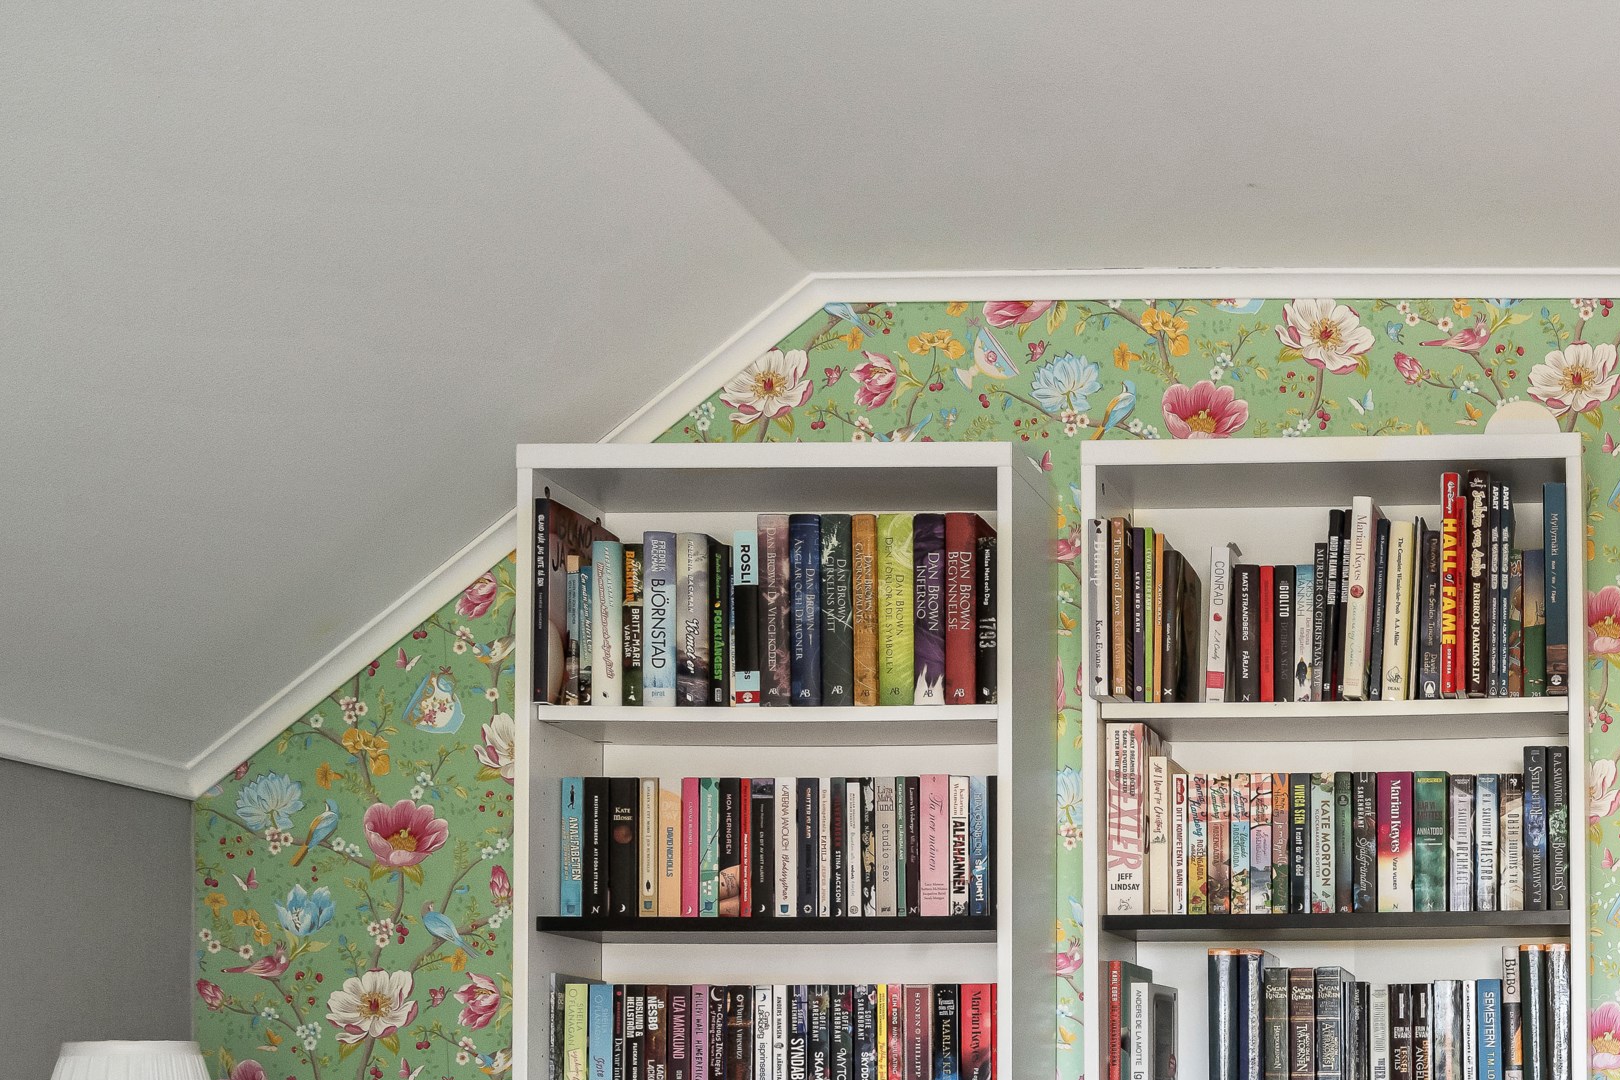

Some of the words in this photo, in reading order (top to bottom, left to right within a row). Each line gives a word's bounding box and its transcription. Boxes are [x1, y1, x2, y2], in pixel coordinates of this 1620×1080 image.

[1355, 514, 1367, 550] Marian
[1443, 518, 1457, 572] HALL
[658, 540, 666, 572] FREDRIK
[794, 538, 803, 579] ÄNGLAR
[836, 559, 846, 582] DAN
[864, 555, 872, 577] DAN
[928, 552, 939, 579] DAN
[960, 551, 971, 579] DAN
[1114, 558, 1122, 580] Food
[1316, 549, 1324, 592] MURDER
[1352, 552, 1365, 581] Keyes
[794, 582, 803, 604] OCH
[806, 568, 815, 590] DAN
[864, 580, 873, 611] BROWN
[895, 574, 904, 596] DAN
[916, 565, 926, 619] INFERNO
[948, 551, 958, 631] BEGYNNELSE
[1114, 582, 1122, 591] of
[1214, 561, 1224, 606] CONRAD
[1445, 574, 1454, 583] of
[806, 594, 815, 631] BROWN
[836, 585, 846, 623] BROWN
[896, 600, 904, 636] BROWN
[928, 585, 939, 631] BROWN
[960, 584, 971, 630] BROWN
[1114, 594, 1122, 615] Love
[1280, 585, 1289, 617] GIOLITO
[1315, 594, 1323, 609] ON
[1442, 586, 1456, 645] FAME
[1473, 582, 1481, 624] FARBROR
[632, 608, 640, 667] BRITT-MARIE
[651, 578, 669, 669] BJÖRNSTAD
[794, 609, 803, 660] DEMONER
[979, 617, 996, 648] 1793
[1314, 611, 1323, 666] CHRISTMAS
[1472, 625, 1480, 666] JOAKIMS
[1313, 669, 1321, 687] EVE
[1472, 668, 1480, 684] LIV
[1321, 800, 1330, 829] KATE
[1391, 780, 1401, 819] Marian
[1107, 770, 1143, 870] DEXTER
[1389, 820, 1401, 853] Keyes
[569, 817, 582, 881] ANALFABETEN
[882, 823, 891, 859] studio
[952, 820, 965, 894] ALFAHANNEN
[1322, 832, 1331, 886] MORTON
[1481, 841, 1493, 880] MAESTRO
[1504, 958, 1517, 995] BILBO
[626, 997, 636, 1038] HELLSTRÖM
[635, 997, 643, 1031] ROSLUND
[648, 996, 657, 1030] NESBØ
[657, 999, 665, 1009] JO
[673, 996, 685, 1013] LIZA
[1484, 991, 1495, 1048] SEMESTERN
[672, 1015, 685, 1059] MARKLUND
[1136, 1020, 1141, 1029] DE
[1487, 1052, 1495, 1068] T.M.
